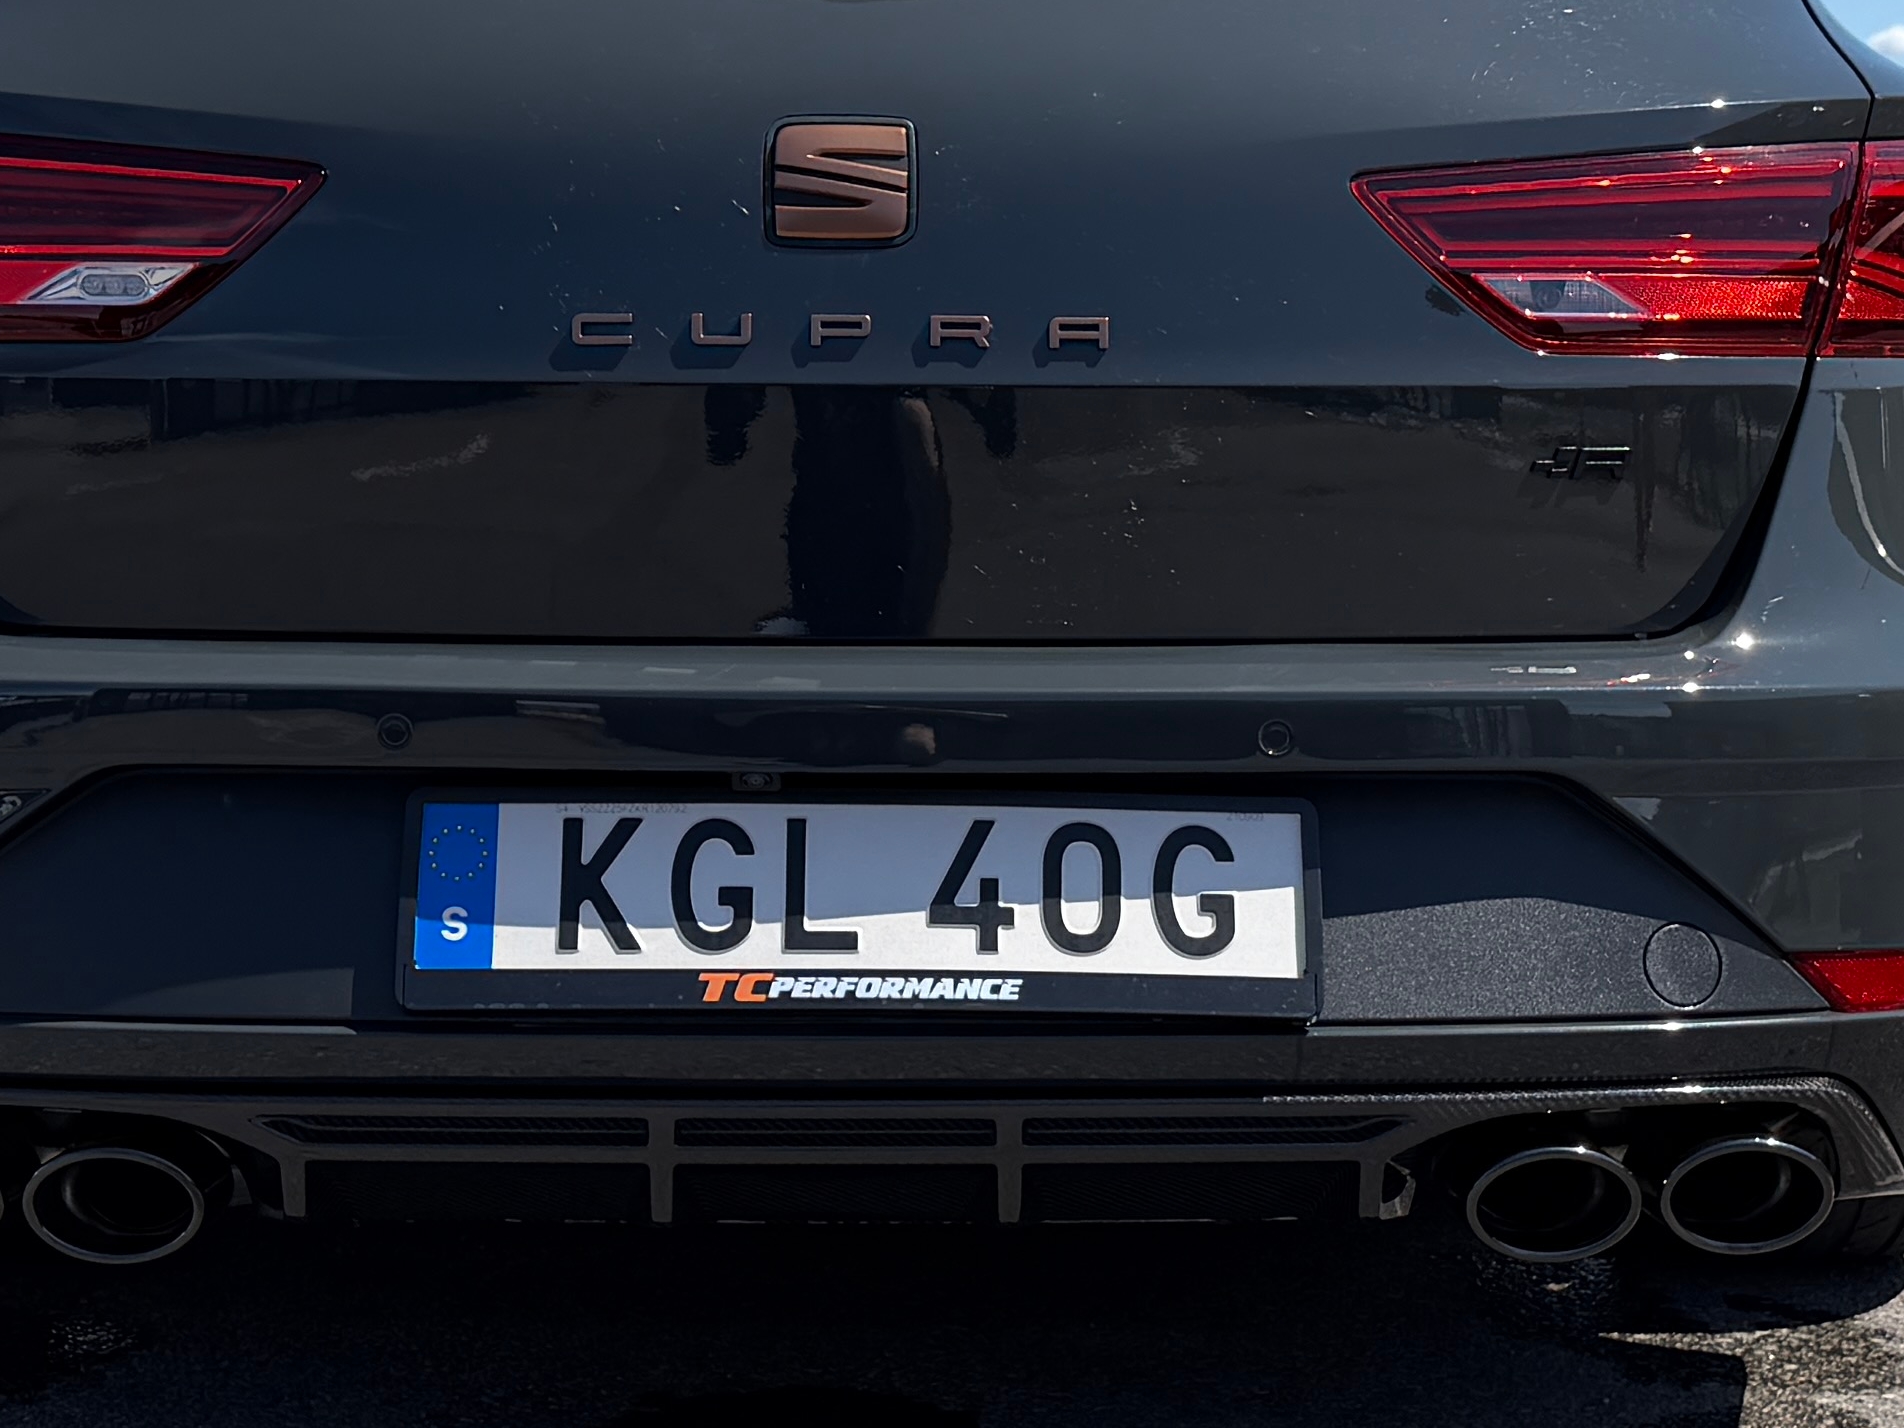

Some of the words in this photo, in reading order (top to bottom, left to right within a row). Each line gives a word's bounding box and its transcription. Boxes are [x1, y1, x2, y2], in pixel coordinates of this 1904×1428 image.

[570, 311, 1111, 350] CUPRA
[555, 816, 862, 957] KGL
[925, 818, 1238, 960] 40G
[439, 906, 470, 943] S
